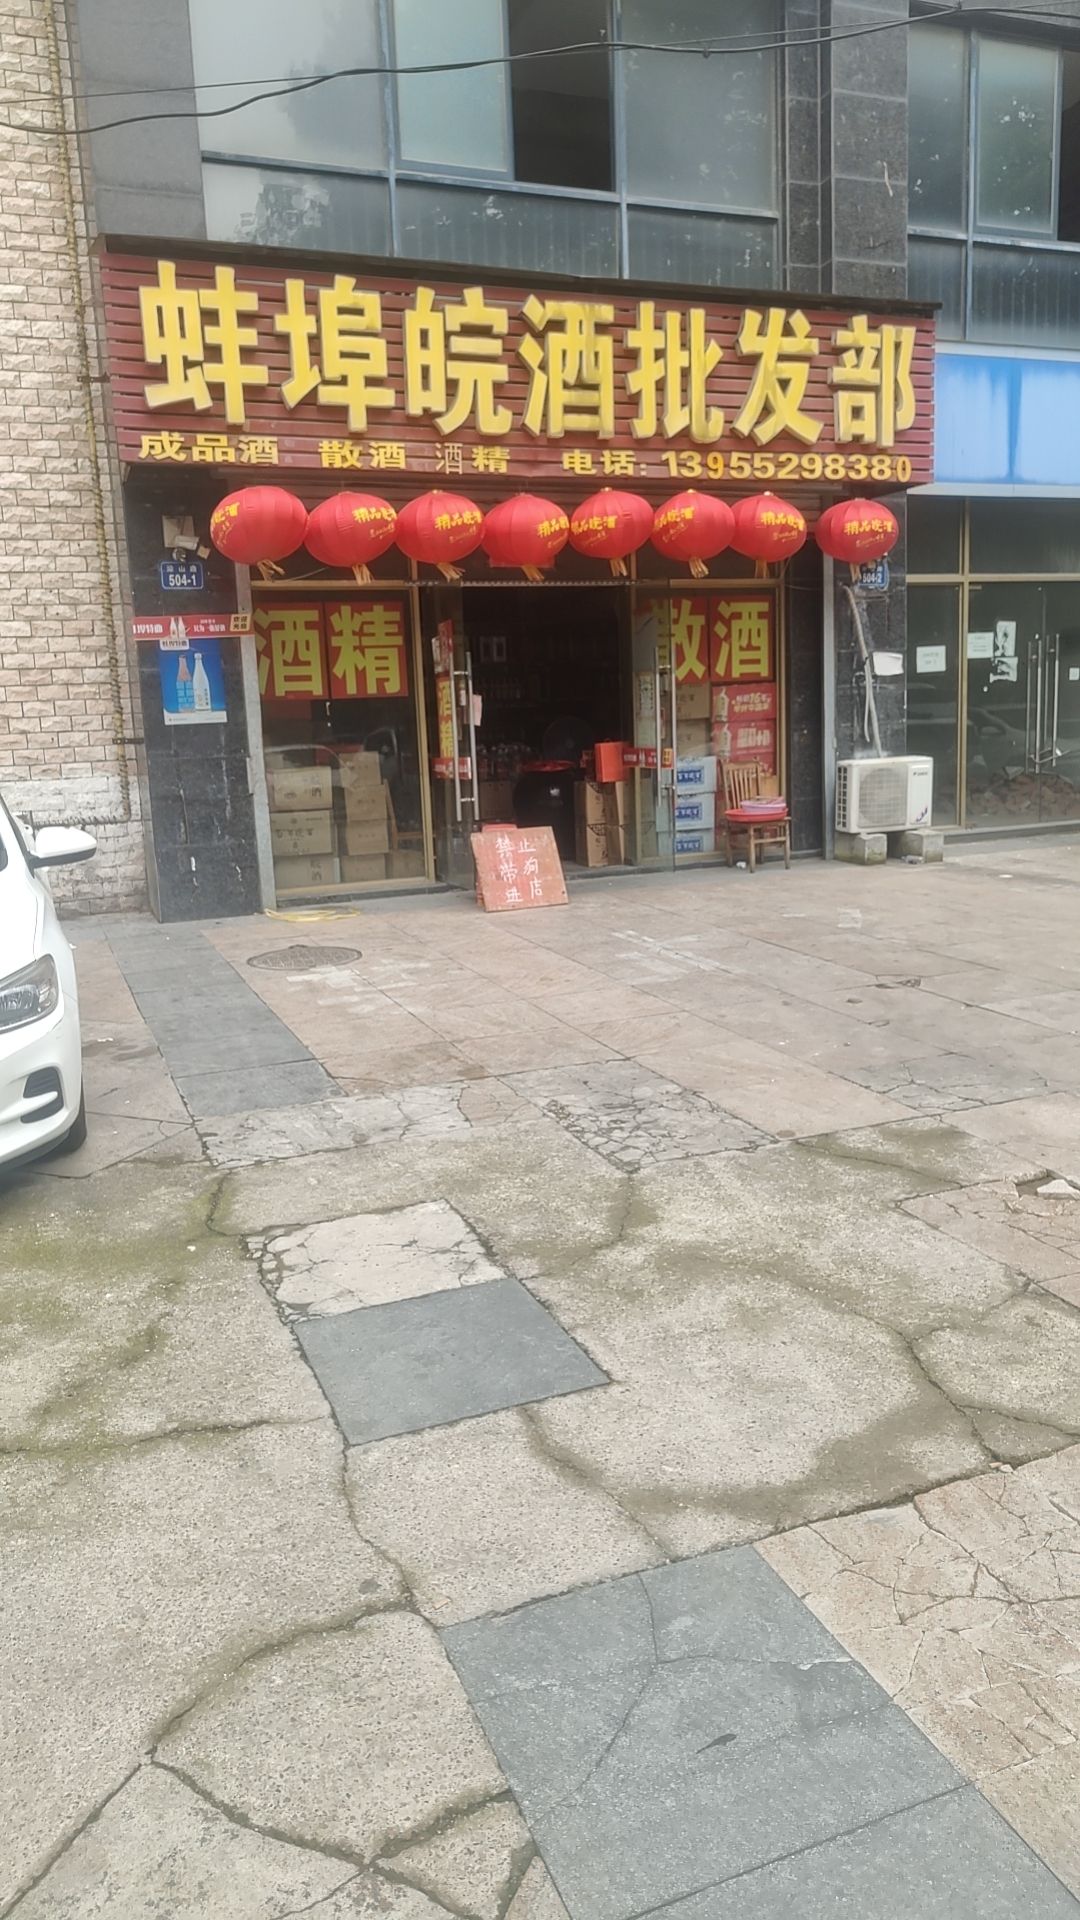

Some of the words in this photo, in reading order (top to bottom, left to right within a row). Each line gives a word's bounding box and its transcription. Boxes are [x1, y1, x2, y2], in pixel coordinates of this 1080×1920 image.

[138, 259, 917, 447] 蚌埠皖酒批发部
[138, 431, 279, 465] 成品酒
[318, 439, 407, 470] 散酒
[434, 442, 511, 475] 酒精
[168, 573, 197, 586] 504-1
[253, 604, 403, 696] 酒精
[496, 834, 537, 859] 禁止
[500, 857, 539, 884] 带狗
